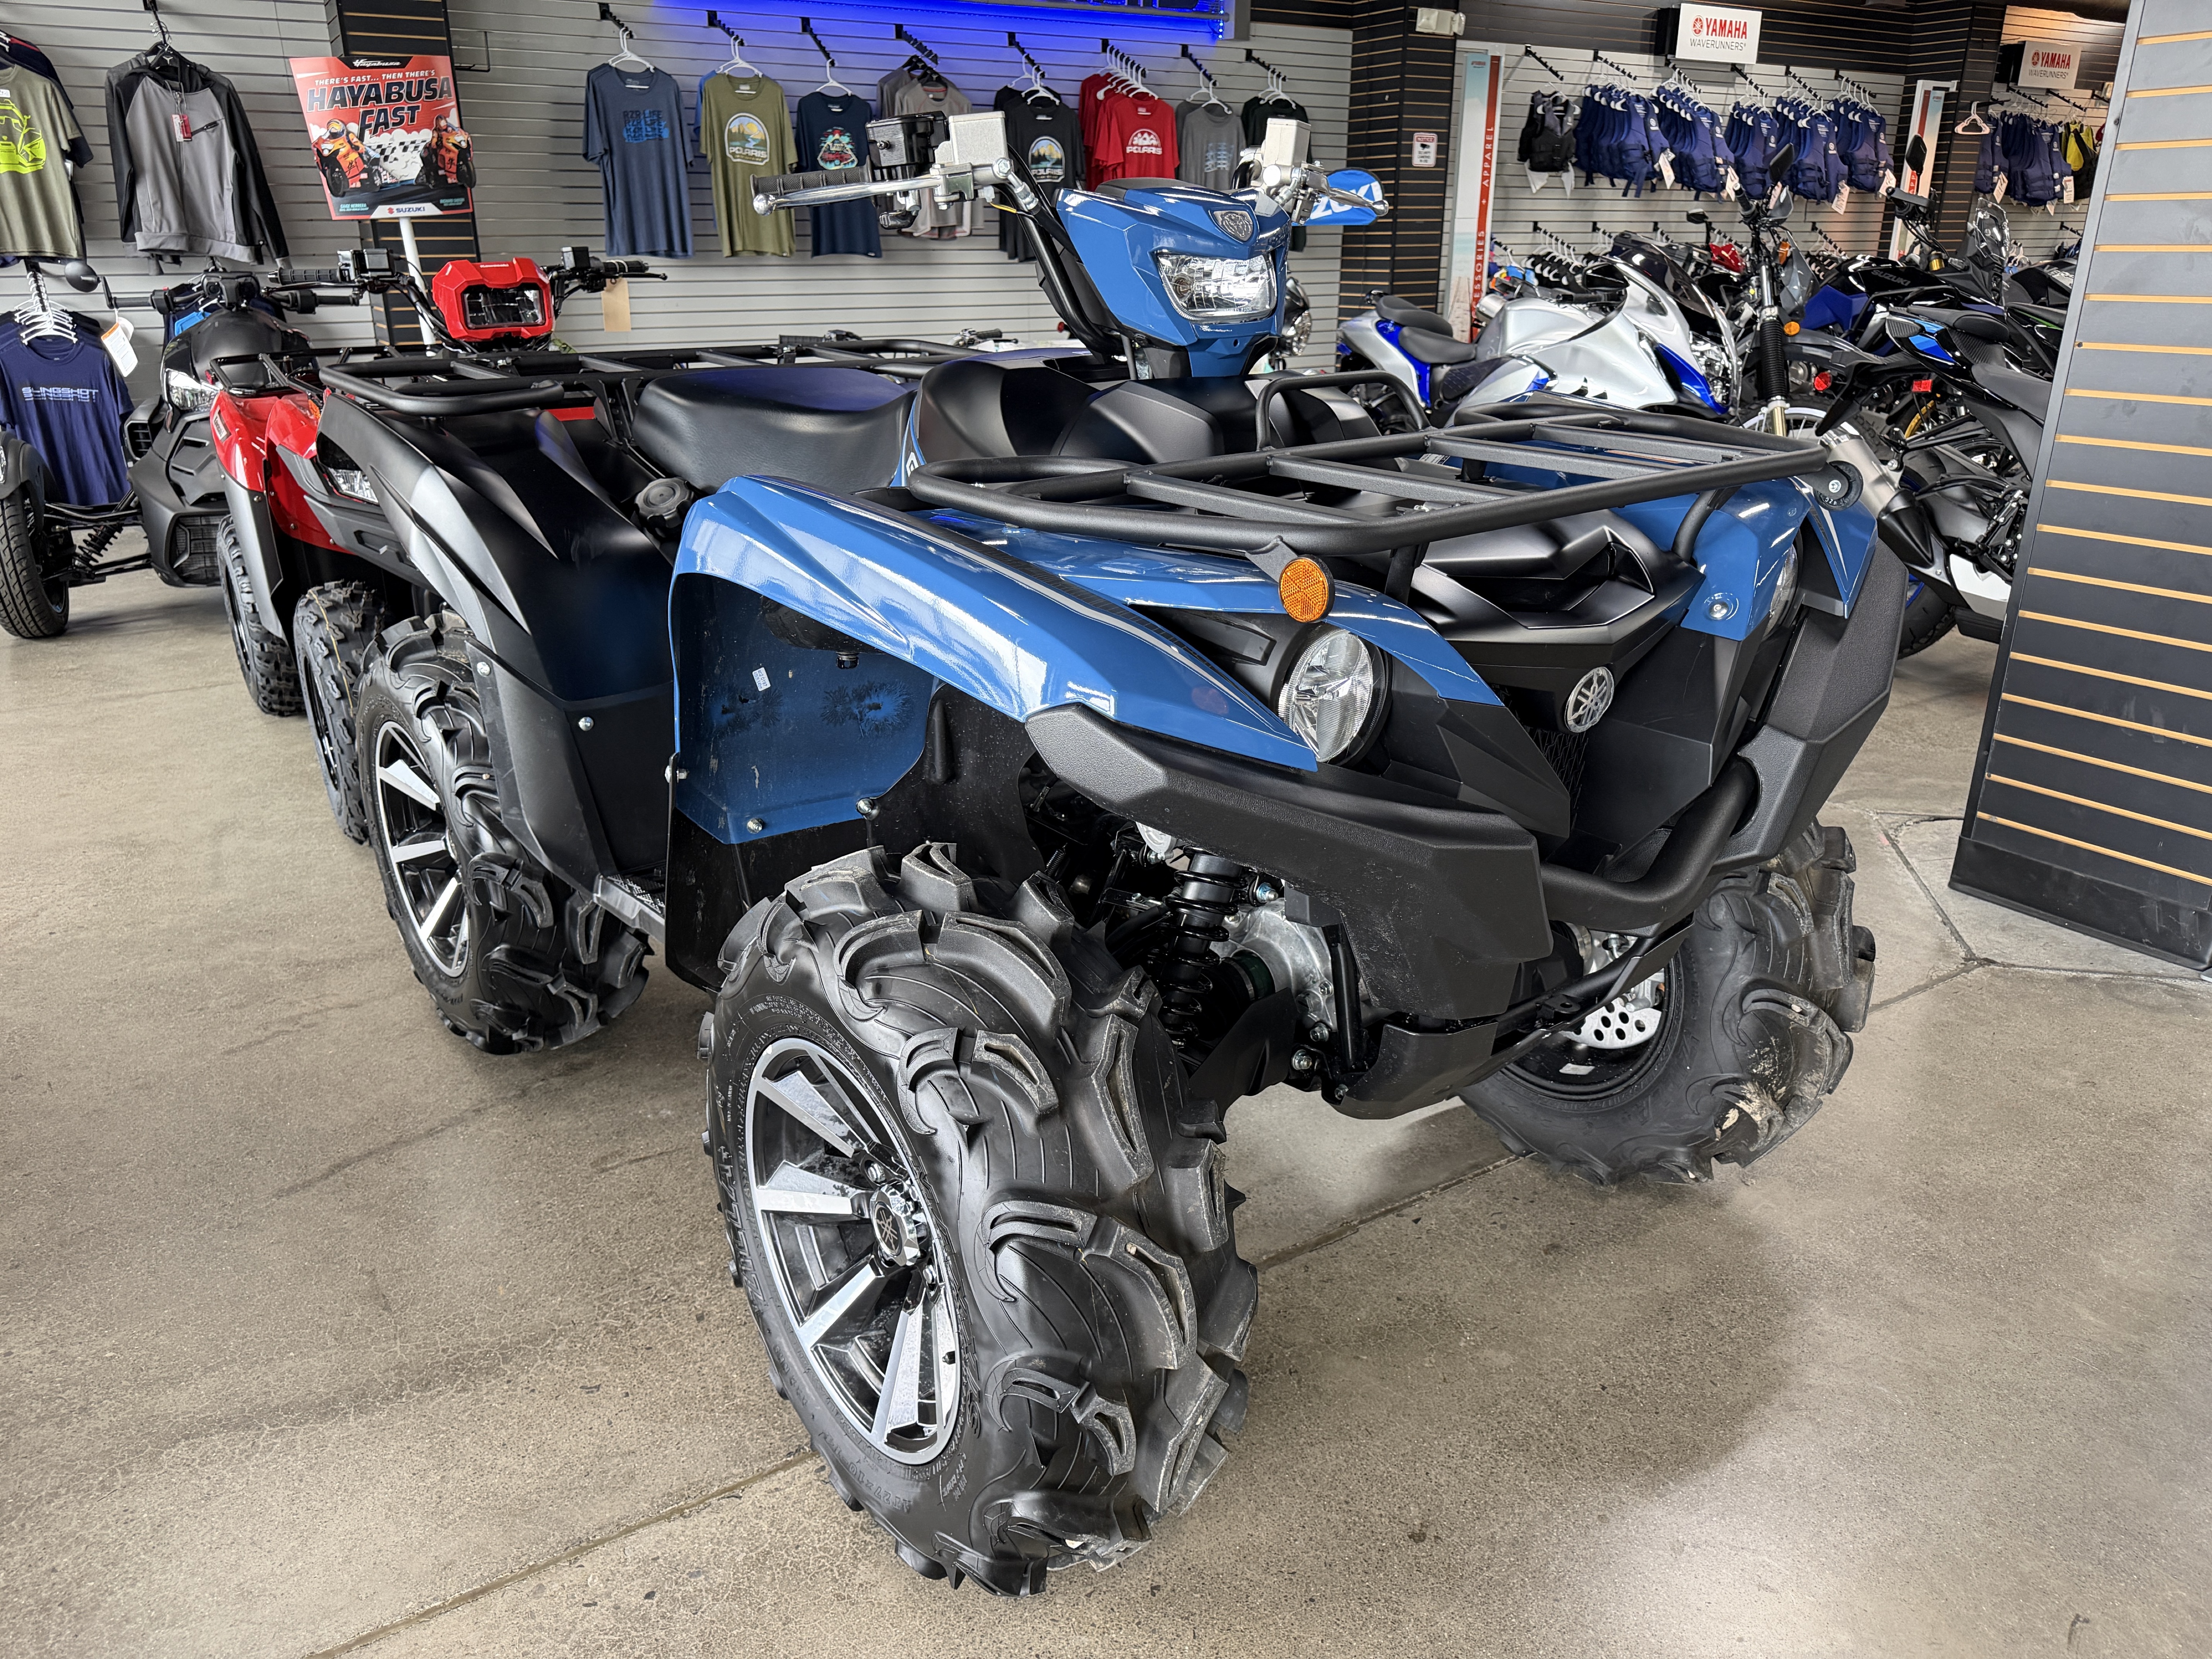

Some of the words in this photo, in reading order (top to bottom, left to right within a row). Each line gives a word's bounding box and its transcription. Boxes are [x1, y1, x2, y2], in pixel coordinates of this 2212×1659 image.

[1706, 18, 1747, 39] YAMAHA
[2041, 51, 2071, 69] YAMAHA
[315, 76, 349, 86] THERE'S
[382, 72, 403, 80] THEN
[405, 69, 435, 78] THERE'S
[307, 76, 453, 113] HAYABUSA
[359, 103, 422, 143] FAST
[729, 147, 768, 158] POLARIS
[1126, 147, 1163, 155] POLARIS
[1482, 127, 1494, 187] APPAREL
[1871, 270, 1911, 286] SUZUKI
[22, 387, 99, 398] SLINGSHOT
[718, 1163, 765, 1302] ZILLA
